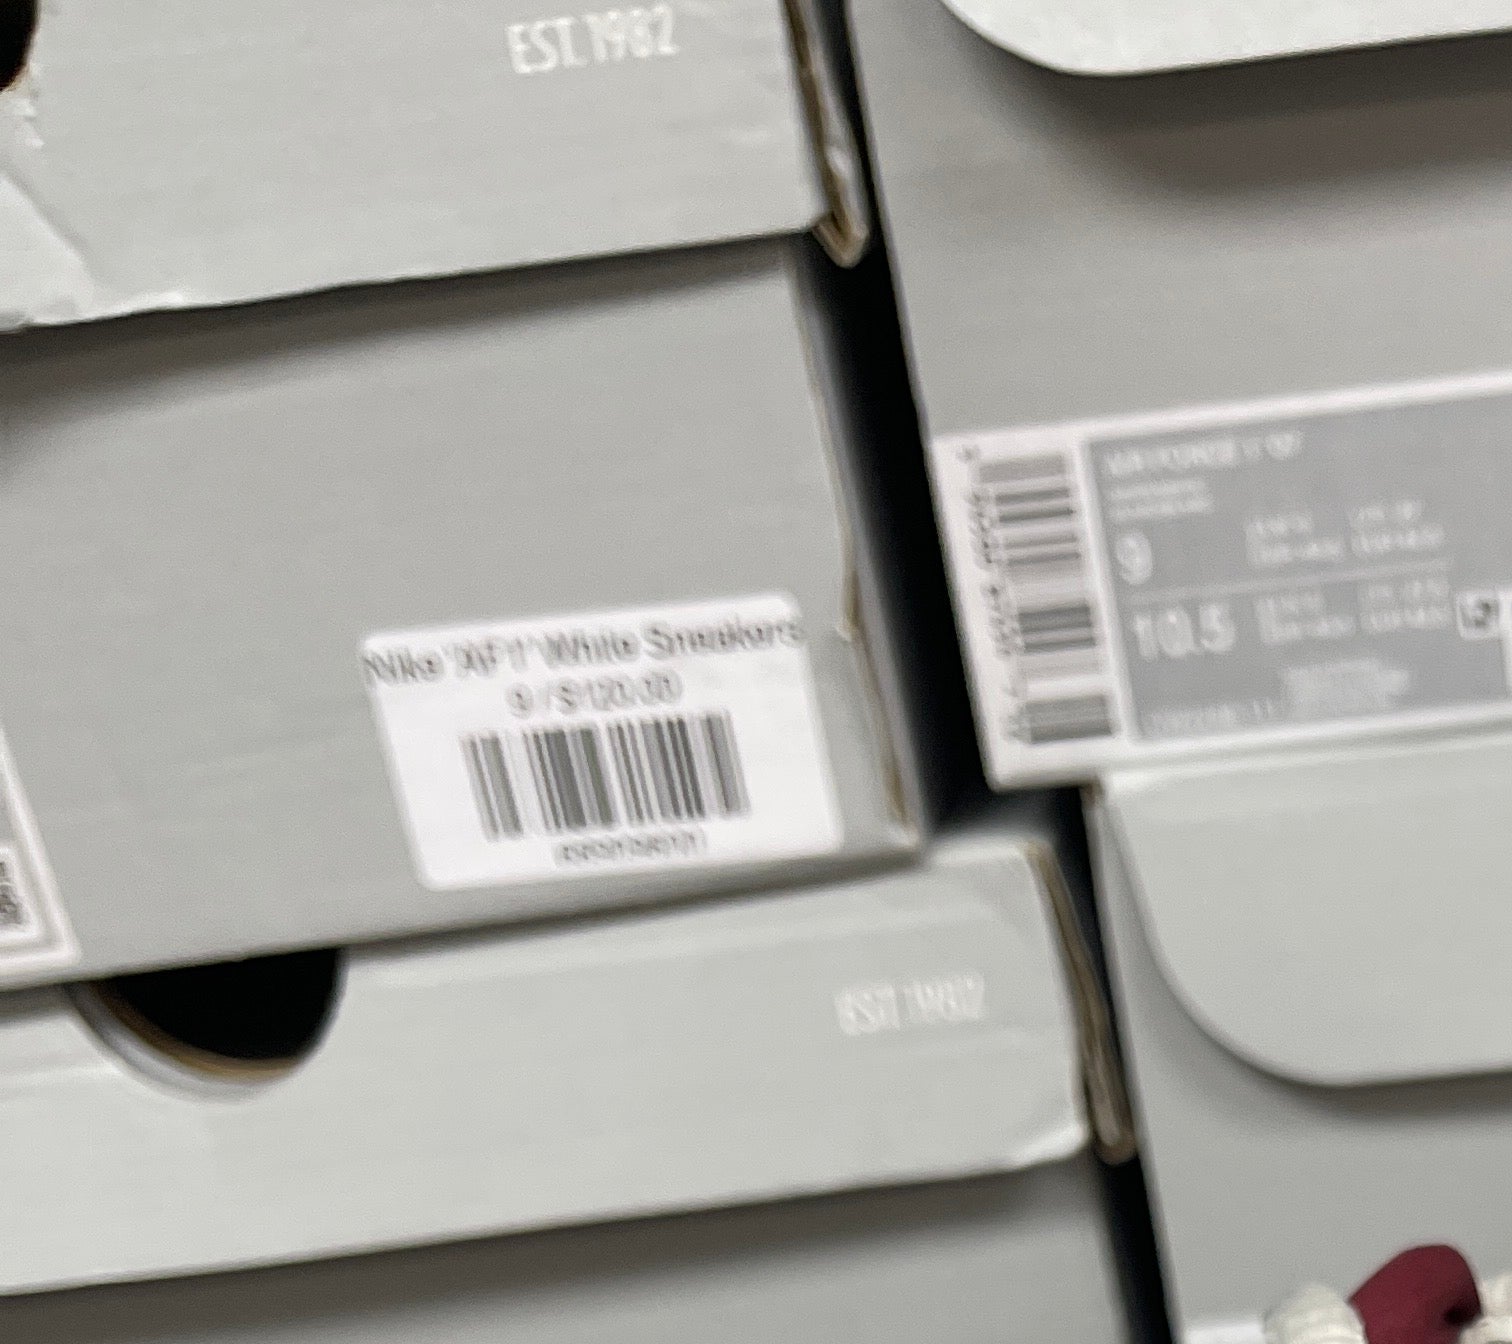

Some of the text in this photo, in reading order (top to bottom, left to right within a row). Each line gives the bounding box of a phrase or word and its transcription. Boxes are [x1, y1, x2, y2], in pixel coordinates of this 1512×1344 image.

[1115, 529, 1154, 586] 9
[539, 630, 641, 670] White
[1131, 601, 1238, 662] 10.5
